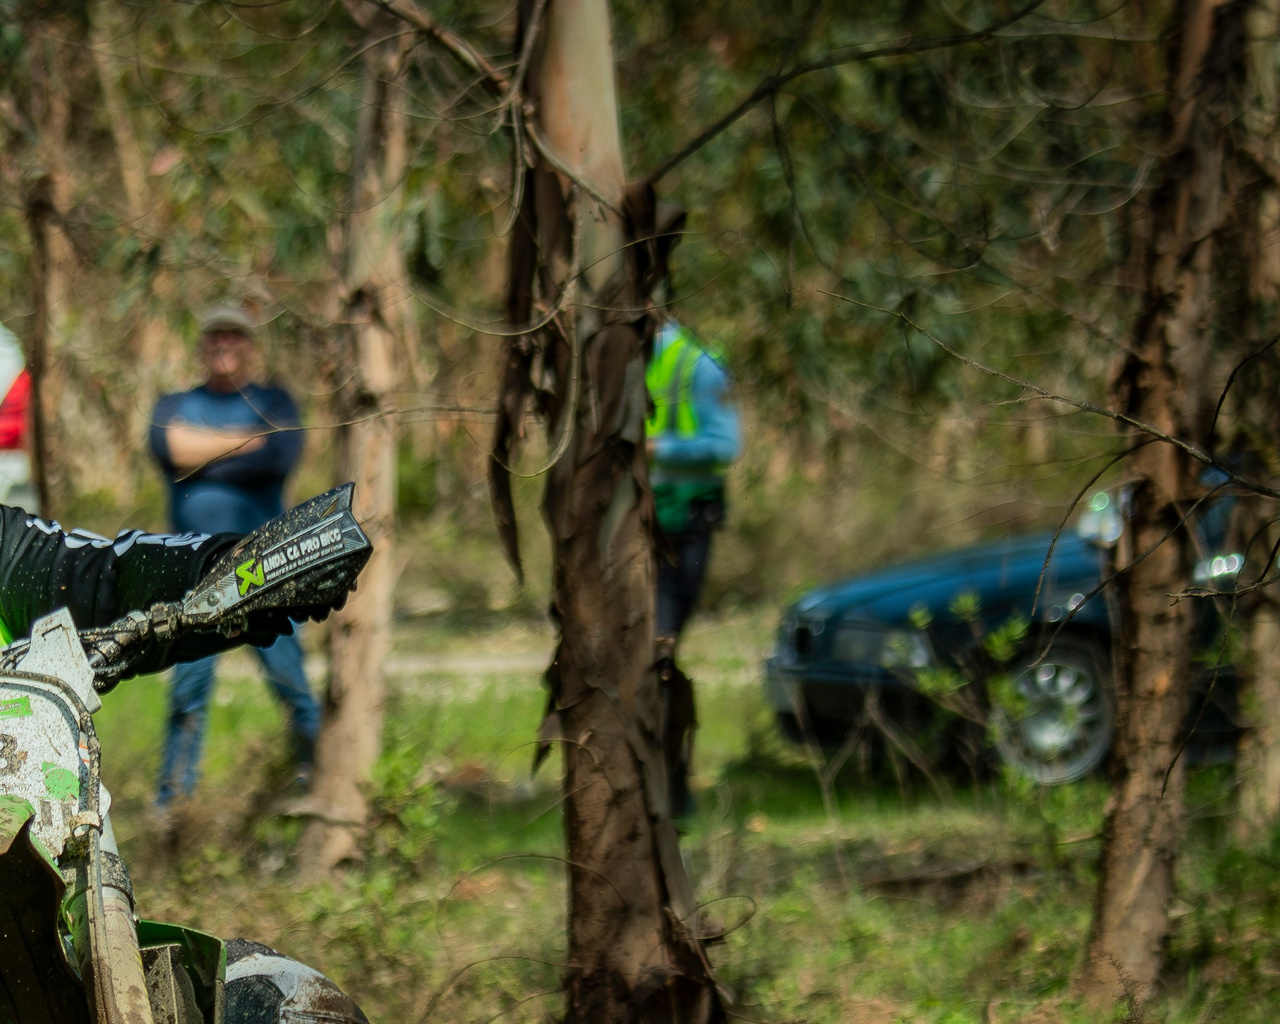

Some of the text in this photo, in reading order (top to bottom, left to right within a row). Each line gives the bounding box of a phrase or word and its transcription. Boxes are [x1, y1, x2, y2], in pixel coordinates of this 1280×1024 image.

[263, 551, 287, 573] ANDA
[300, 536, 320, 556] PRO
[320, 528, 342, 547] BICO
